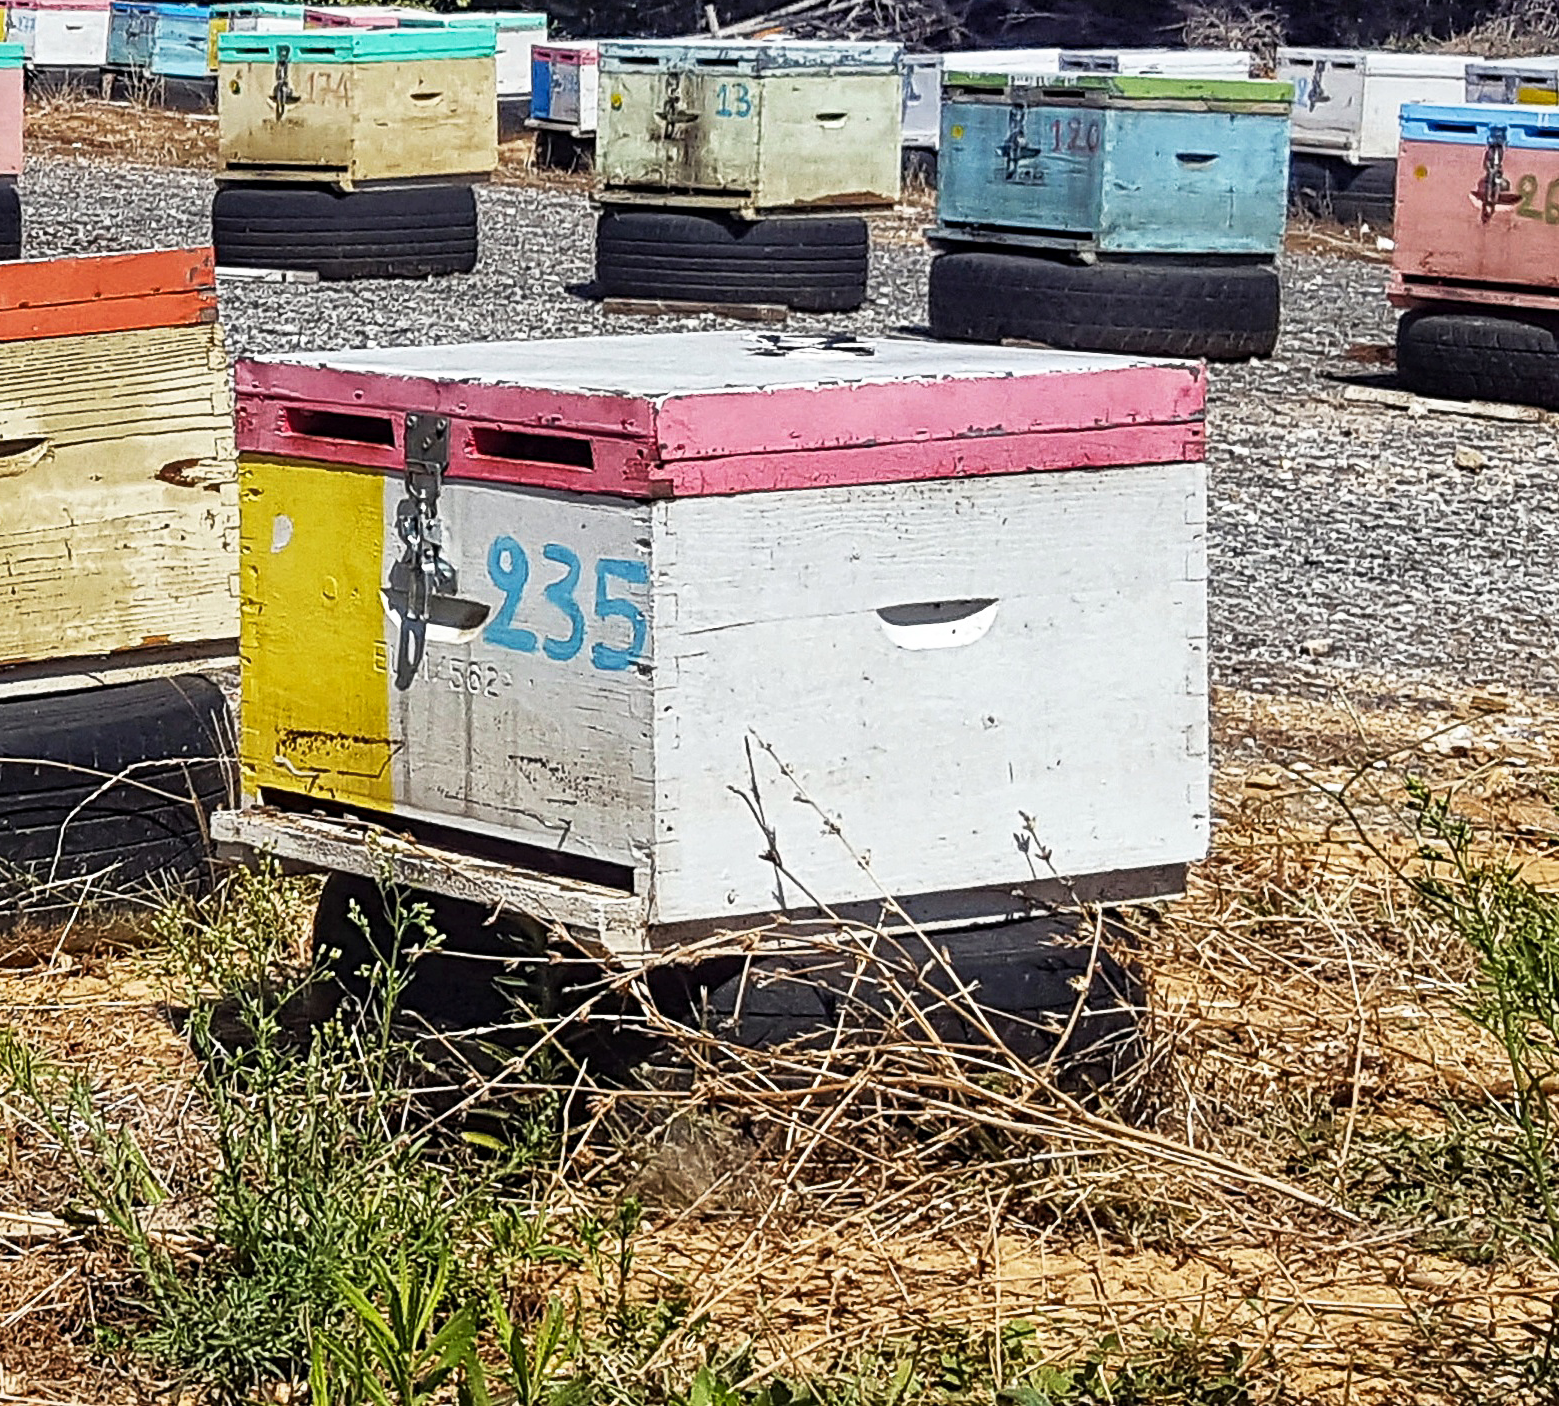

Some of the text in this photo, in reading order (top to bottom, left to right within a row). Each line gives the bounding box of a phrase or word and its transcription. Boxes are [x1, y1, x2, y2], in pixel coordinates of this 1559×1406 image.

[304, 71, 355, 107] 174
[715, 82, 752, 118] 13
[1052, 117, 1101, 153] 120
[482, 535, 649, 671] 235
